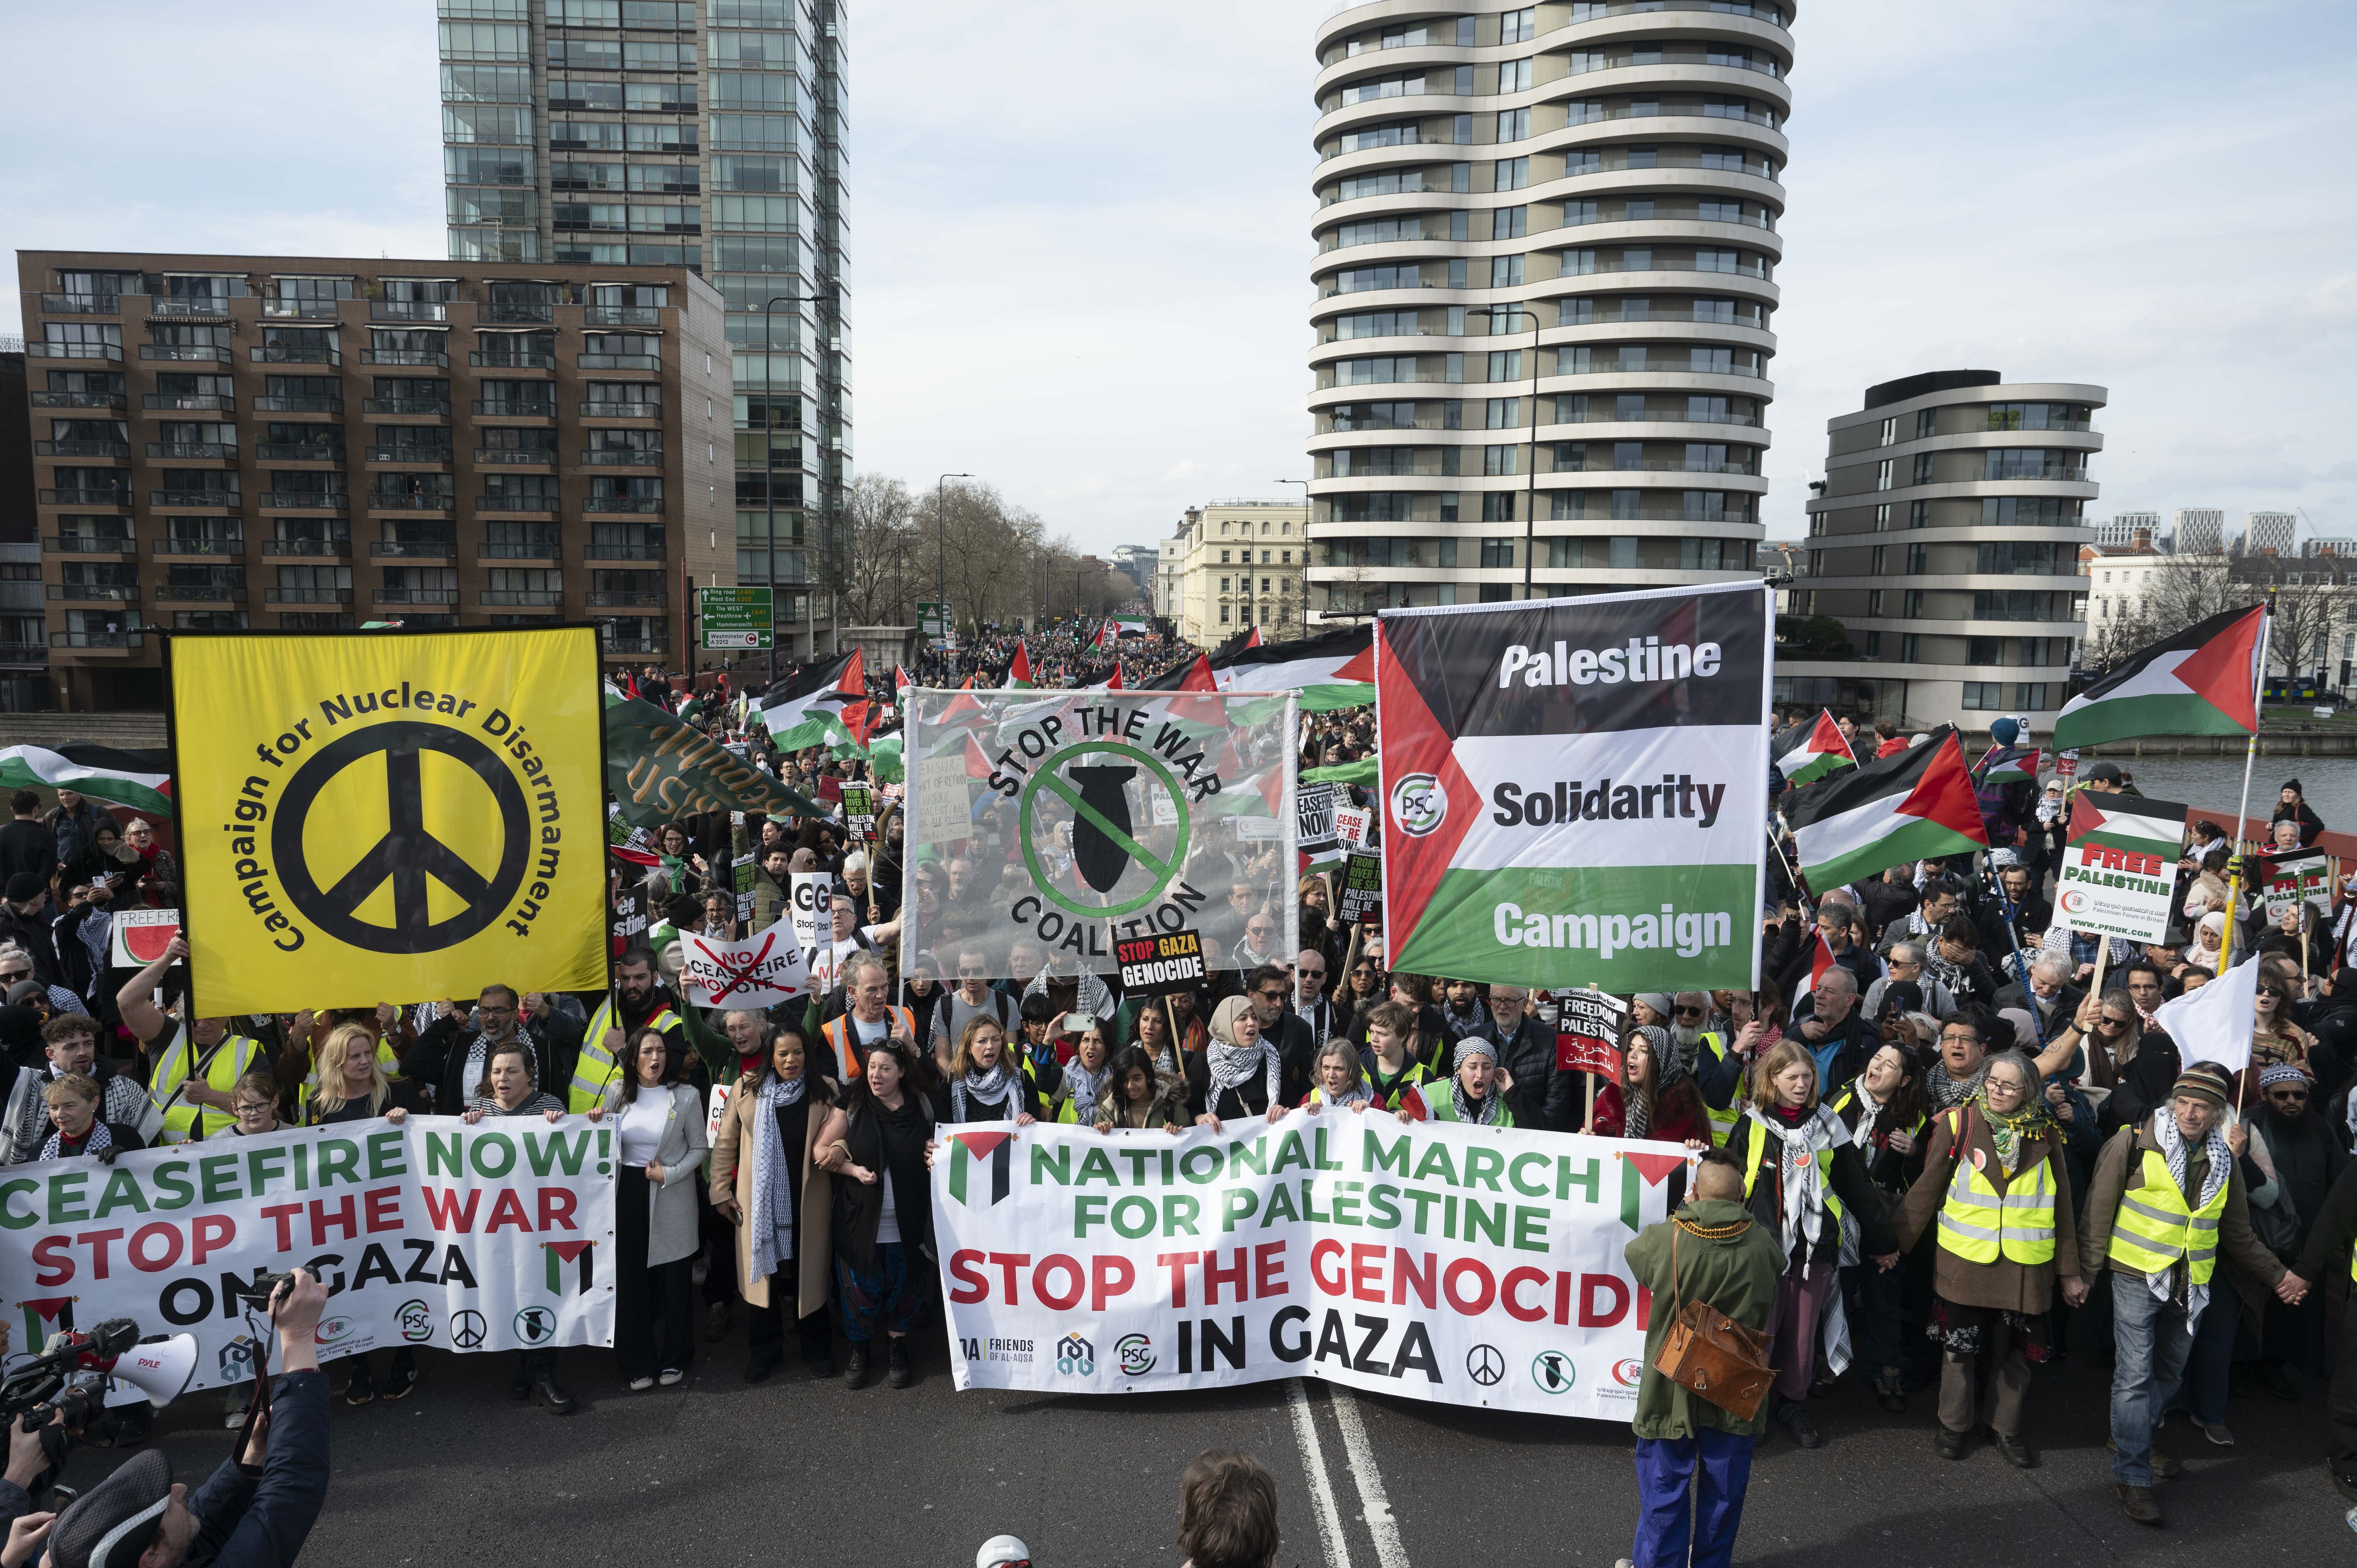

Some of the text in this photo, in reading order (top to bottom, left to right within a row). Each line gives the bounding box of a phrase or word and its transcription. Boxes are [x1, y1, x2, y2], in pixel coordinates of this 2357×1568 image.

[1499, 636, 1721, 689] Palestine
[988, 706, 1222, 804] STOP THE WAR
[919, 759, 963, 775] ENSURE
[934, 774, 966, 788] OF RETURN
[844, 789, 861, 798] FROM
[923, 791, 952, 806] HISTORIC
[1493, 774, 1726, 828] Solidarity
[845, 798, 871, 806] RIVER TO
[1298, 793, 1333, 814] EASEFIRE
[1402, 794, 1435, 814] PSC
[223, 681, 562, 952] Campaign for Nuclear Disarmament
[920, 803, 966, 818] PALESTINE
[848, 815, 876, 823] PALESTINE
[931, 818, 942, 826] ALL
[1299, 809, 1334, 838] NOW!
[1337, 814, 1362, 828] CEASE
[623, 826, 634, 837] SEA
[848, 823, 873, 832] WILL BE
[850, 832, 864, 840] FREE
[1339, 839, 1358, 851] OW!
[1352, 856, 1375, 869] FROM
[2081, 842, 2164, 877] FREE
[736, 865, 749, 876] FROM
[1349, 867, 1373, 879] RIVER
[736, 874, 750, 885] RIVER
[1348, 878, 1378, 890] THE SEA
[2064, 866, 2171, 896] PALESTINE
[737, 884, 746, 894] THE
[1345, 888, 1382, 901] PALESTINE
[2267, 887, 2328, 903] PALETINE
[737, 899, 755, 913] WILL BE
[1343, 899, 1373, 911] WILL BE
[2093, 907, 2121, 916] Palestinian
[120, 912, 155, 926] FREE
[738, 911, 751, 922] FREE
[1011, 881, 1207, 956] COALITION
[1339, 909, 1360, 921] FREE
[797, 920, 814, 929] Stop
[818, 922, 829, 932] Stop
[1493, 902, 1731, 960] Campaign
[2070, 919, 2152, 938] WWW.PFBUK.COM
[1118, 934, 1198, 962] STOP GAZA
[690, 949, 798, 979] CEASEFIRE
[721, 952, 753, 965] NO
[1122, 956, 1203, 987] GENOCIDE
[720, 976, 775, 993] VOTE
[1569, 990, 1617, 1007] Socialist Worker
[1565, 999, 1617, 1026] FREEDOM
[1561, 1019, 1618, 1048] PALESTINE
[1571, 1038, 1610, 1057] الحرية
[1565, 1052, 1614, 1073] لفلسطين
[1030, 1127, 1600, 1203] NATIONAL MARCH
[0, 1129, 611, 1230] CEASEFIRE NOW!
[1074, 1178, 1551, 1253] FOR PALESTINE
[32, 1185, 578, 1287] STOP THE WAR
[159, 1238, 478, 1326] ON GAZA
[949, 1248, 1135, 1311] STOP
[1157, 1240, 1289, 1308] THE
[403, 1314, 429, 1329] PSC
[990, 1338, 1033, 1352] FRIENDS
[1178, 1305, 1443, 1384] IN GAZA
[138, 1358, 161, 1368] PYLE
[990, 1352, 1033, 1363] OF AL-AQSA
[1122, 1348, 1149, 1363] PSC
